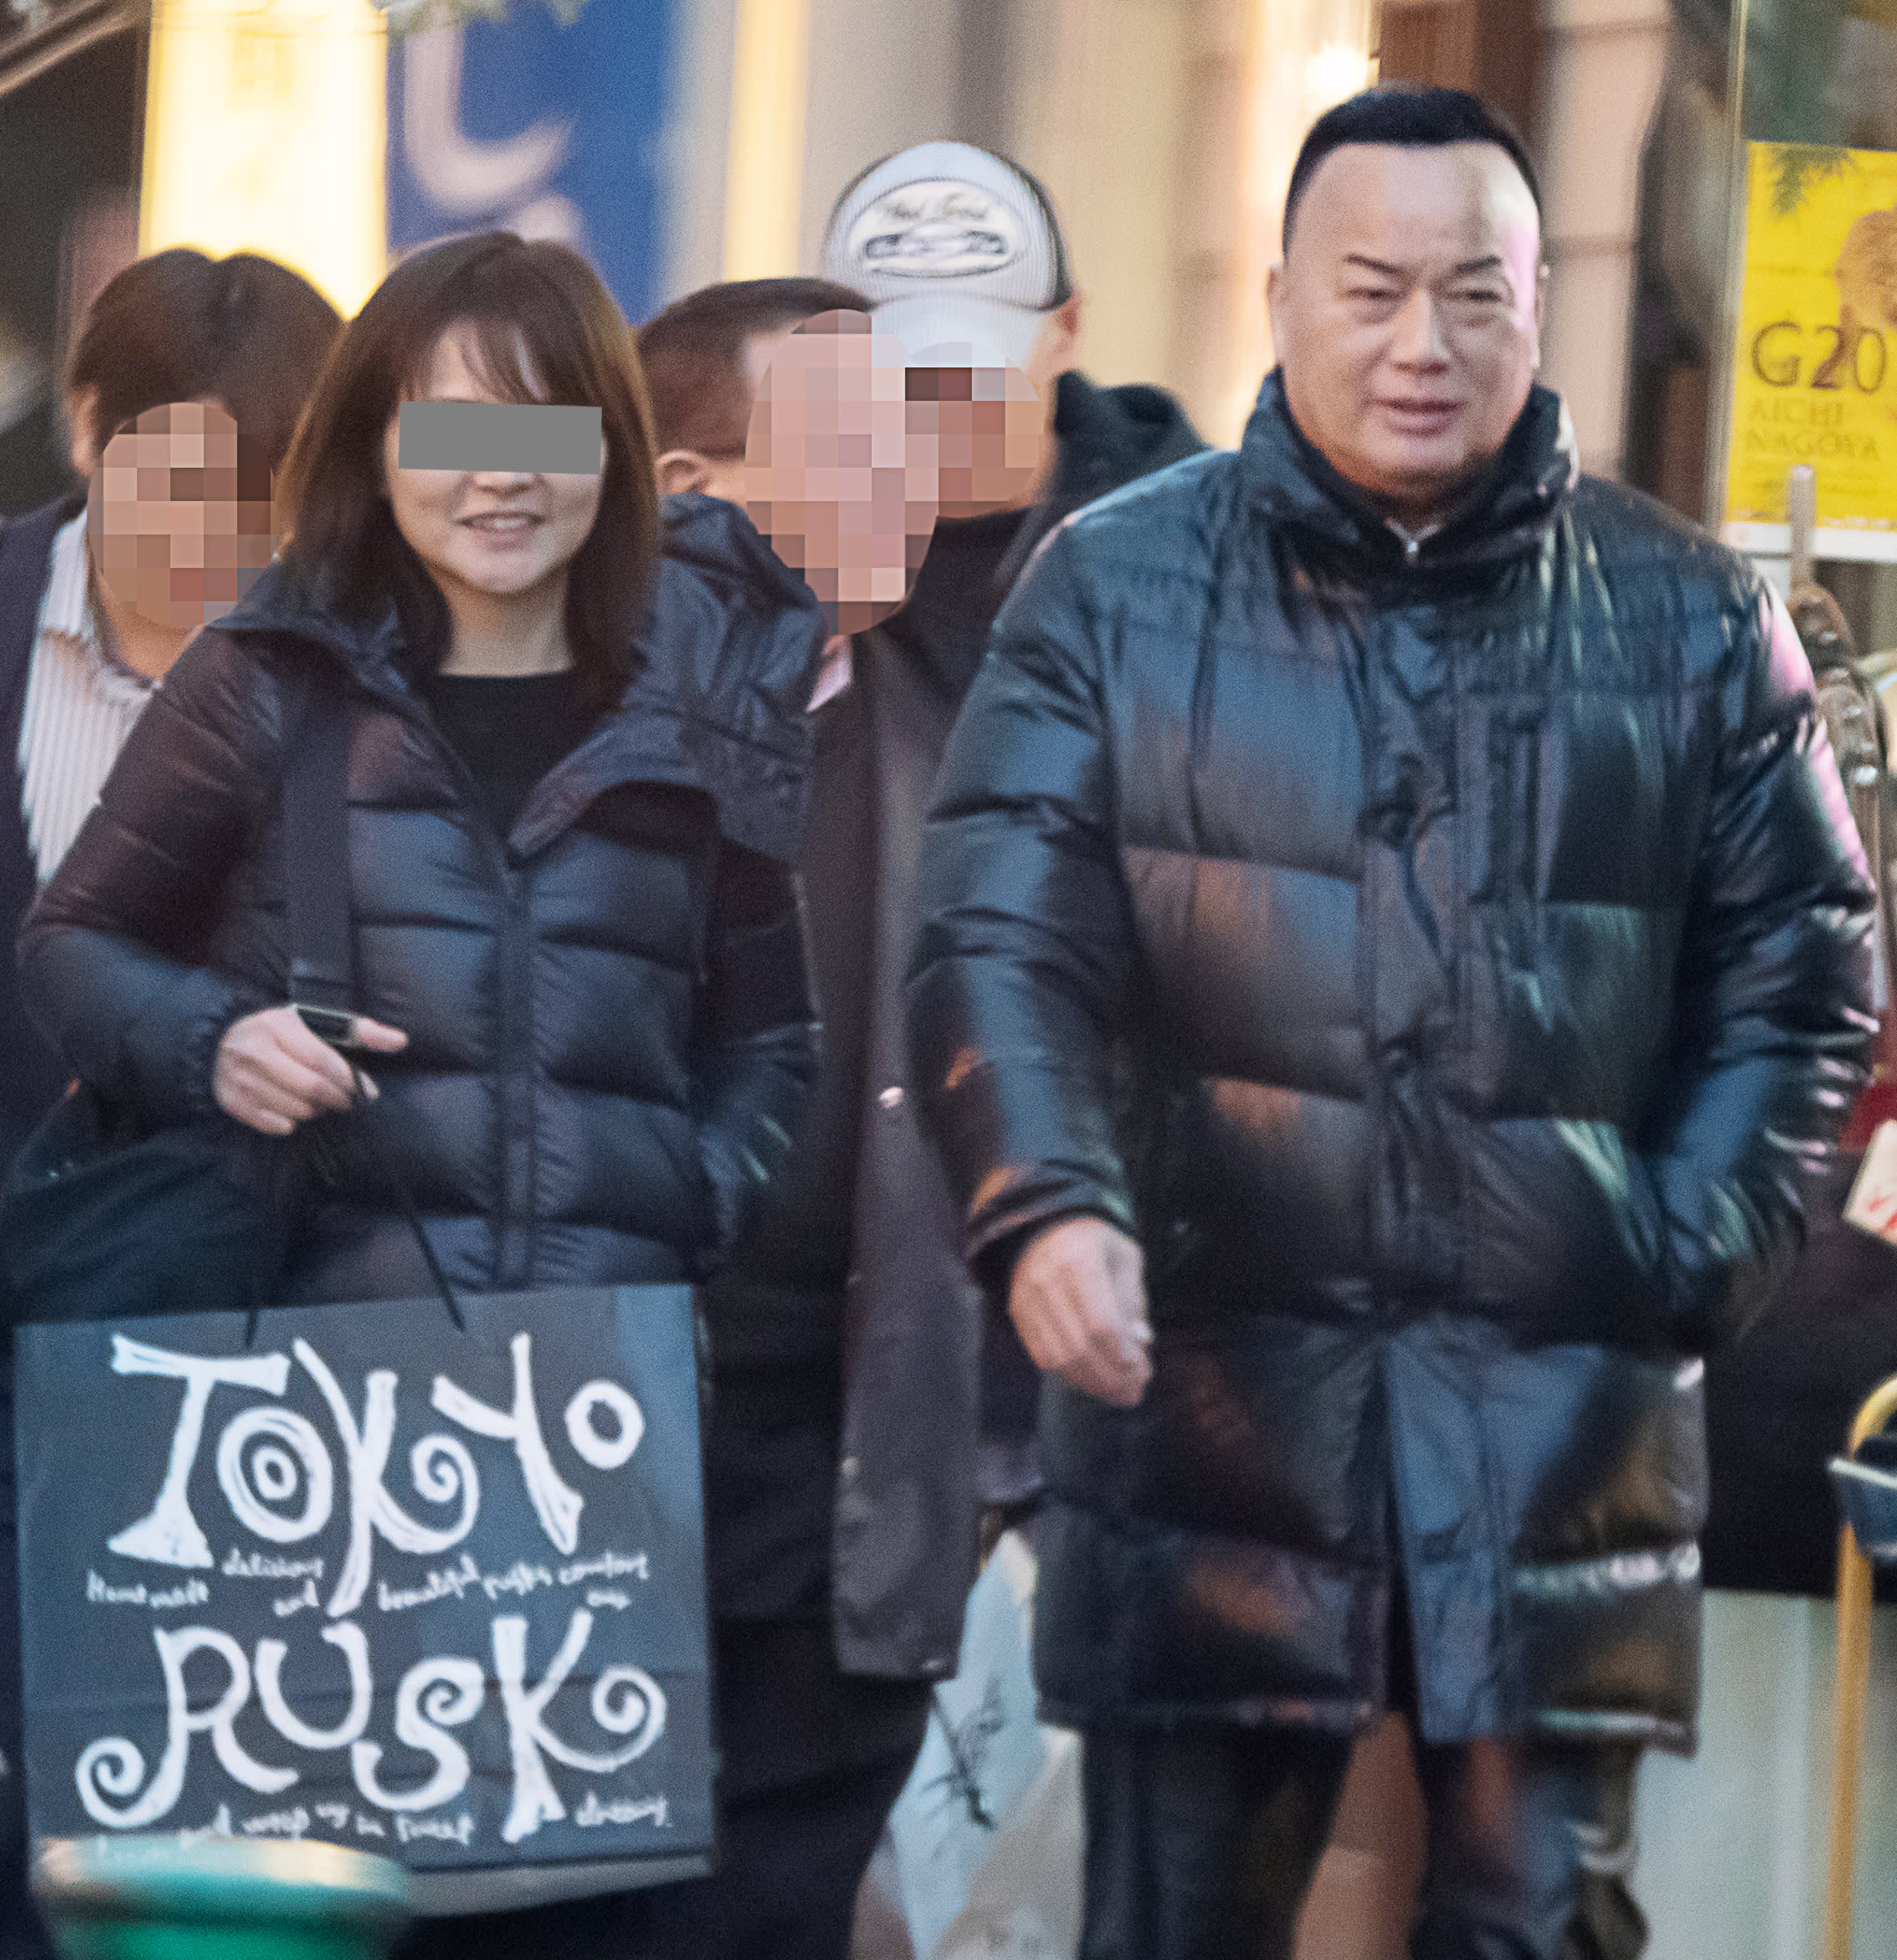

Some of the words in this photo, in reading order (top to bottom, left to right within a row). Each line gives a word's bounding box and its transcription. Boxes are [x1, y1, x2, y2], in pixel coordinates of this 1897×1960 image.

[1753, 319, 1887, 394] G20
[1746, 429, 1880, 460] NAGOYA
[1749, 398, 1845, 428] AICHI
[109, 1333, 645, 1618] TOKYO
[76, 1608, 666, 1843] RUSK
